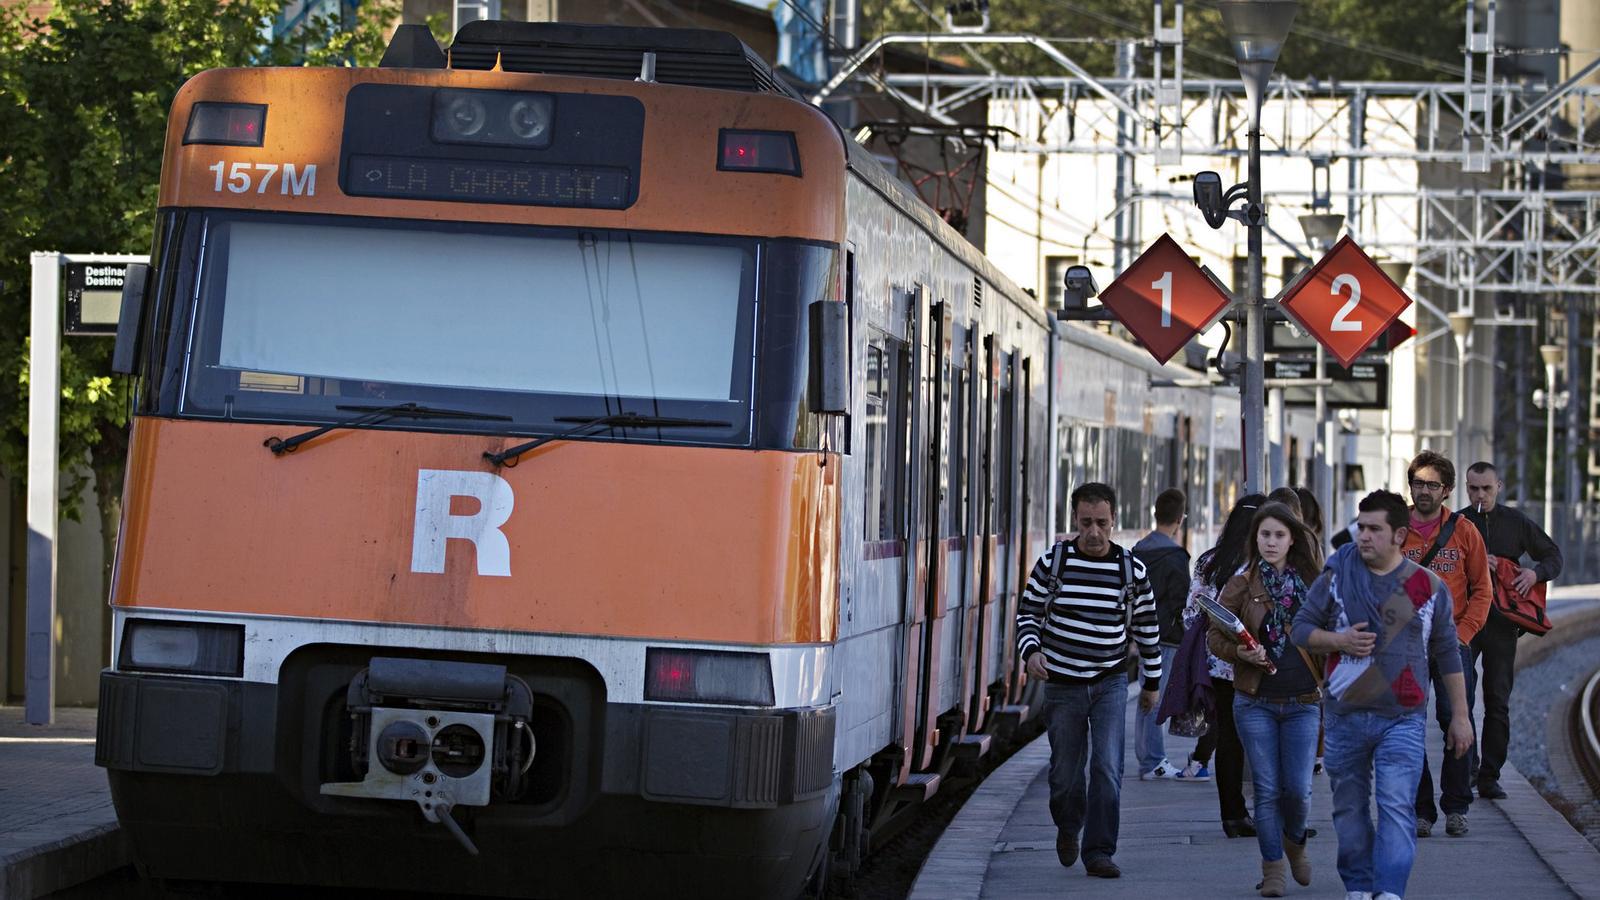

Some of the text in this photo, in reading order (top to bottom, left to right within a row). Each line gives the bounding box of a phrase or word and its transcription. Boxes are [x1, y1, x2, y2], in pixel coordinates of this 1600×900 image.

[209, 161, 317, 196] 157M
[387, 163, 596, 200] LA GARRIGA
[85, 276, 124, 286] Destino
[1151, 271, 1173, 328] 1
[1330, 273, 1362, 331] 2
[411, 469, 515, 577] R
